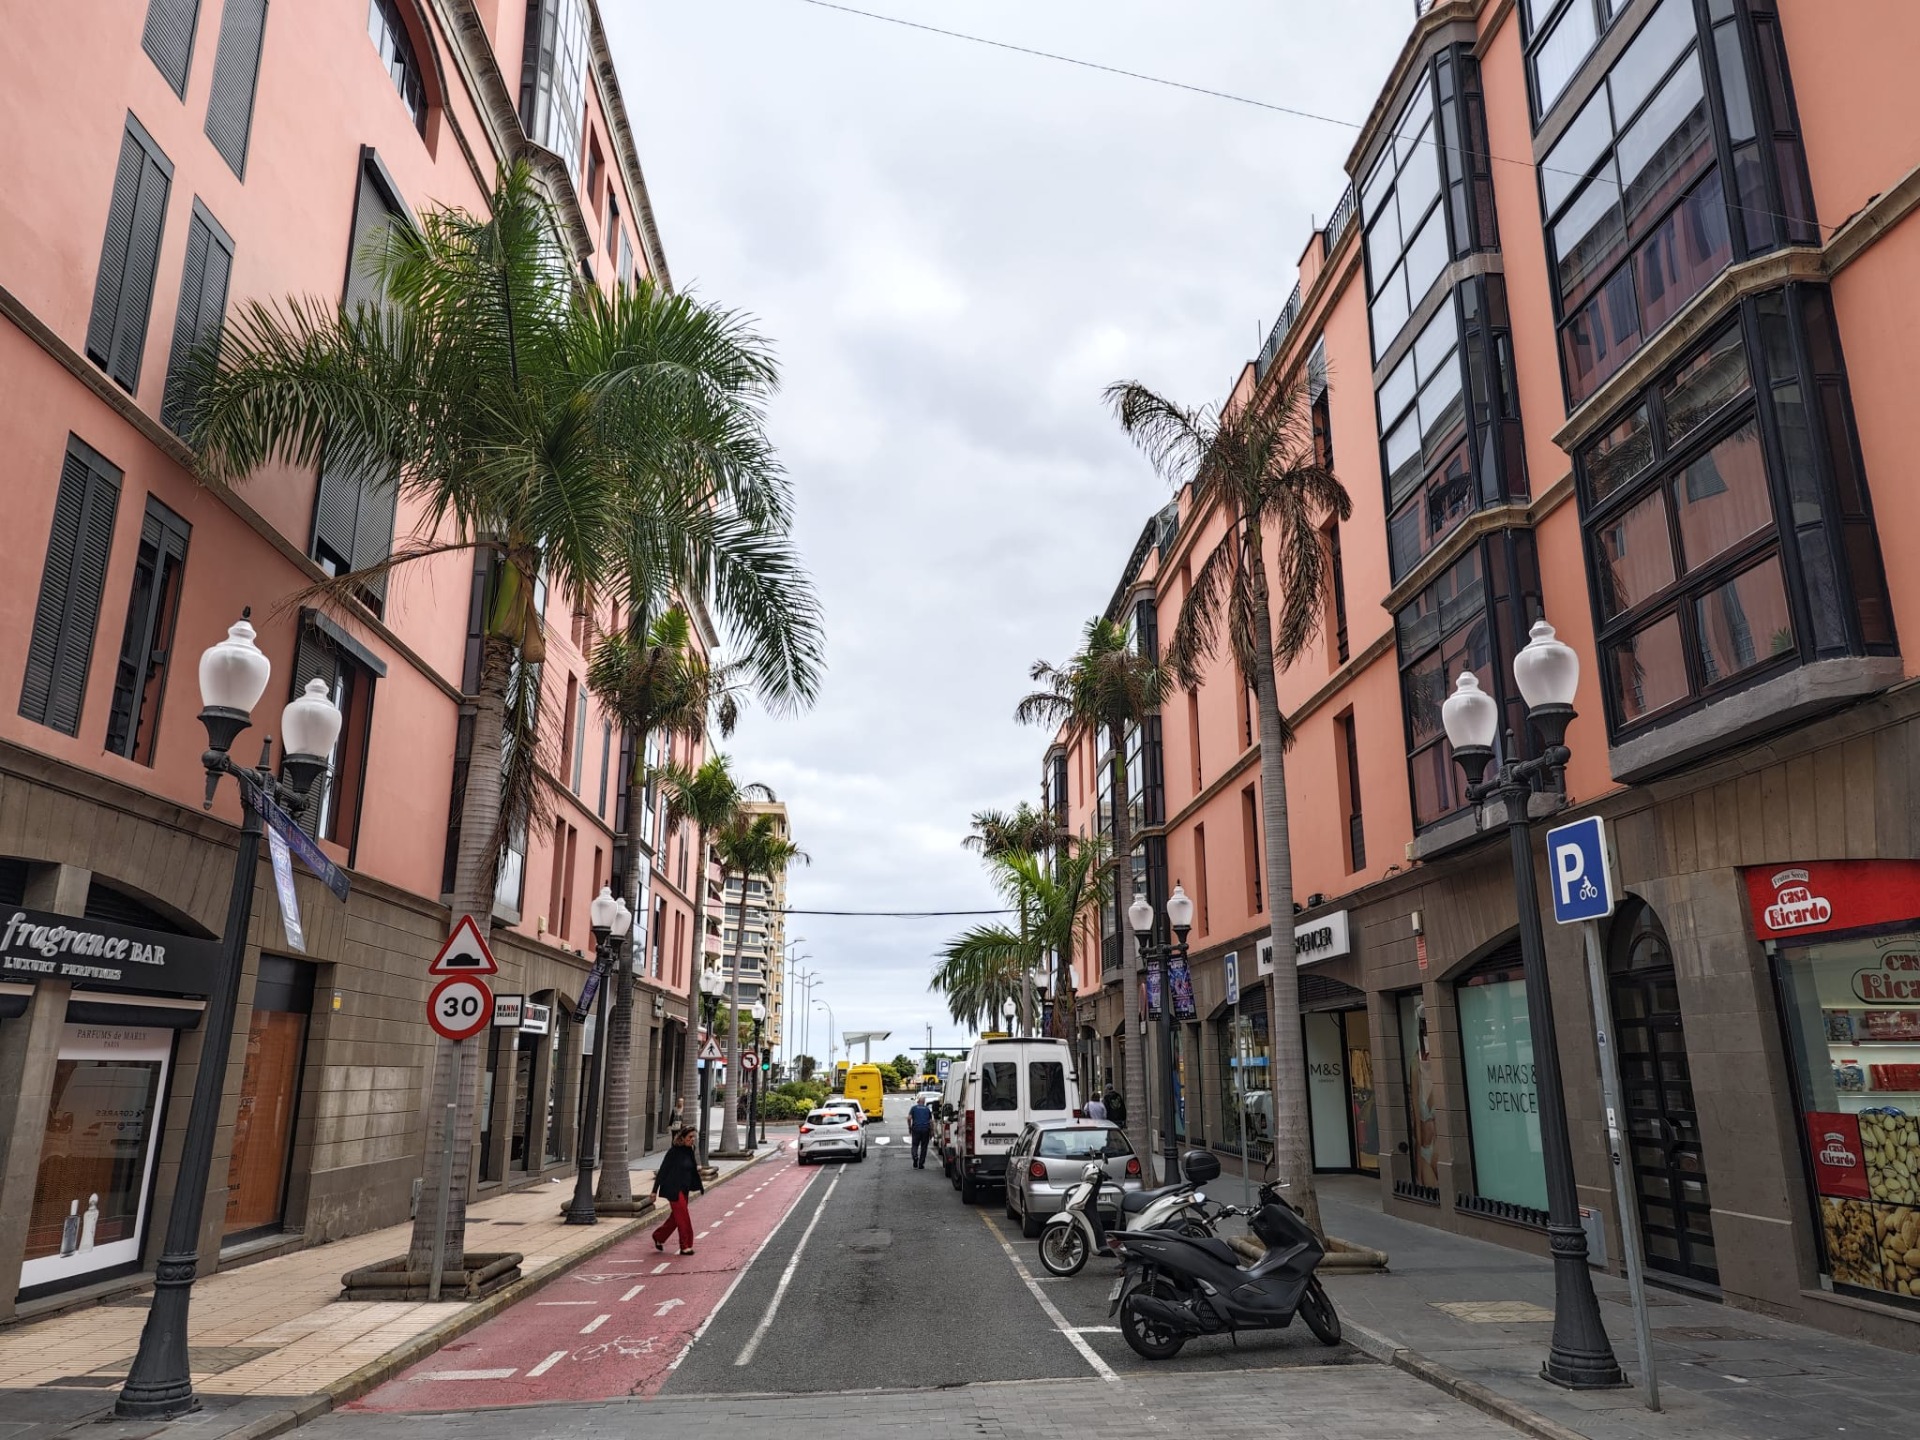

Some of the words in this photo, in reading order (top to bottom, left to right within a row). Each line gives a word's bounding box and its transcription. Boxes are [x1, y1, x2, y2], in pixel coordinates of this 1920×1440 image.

[1556, 843, 1584, 905] P
[1780, 889, 1808, 905] casa
[1768, 902, 1829, 927] Ricardo
[0, 912, 130, 960] fragrance
[129, 942, 166, 966] BAR
[3, 956, 57, 973] LUXURY
[60, 963, 122, 980] PERFUMES
[443, 996, 479, 1017] 30
[77, 1029, 112, 1039] PARFUMS
[113, 1030, 122, 1040] de
[1310, 1063, 1341, 1076] M&S
[1487, 1065, 1529, 1084] MARKS
[1488, 1092, 1537, 1113] SPENCE
[1822, 1152, 1855, 1165] Ricardo
